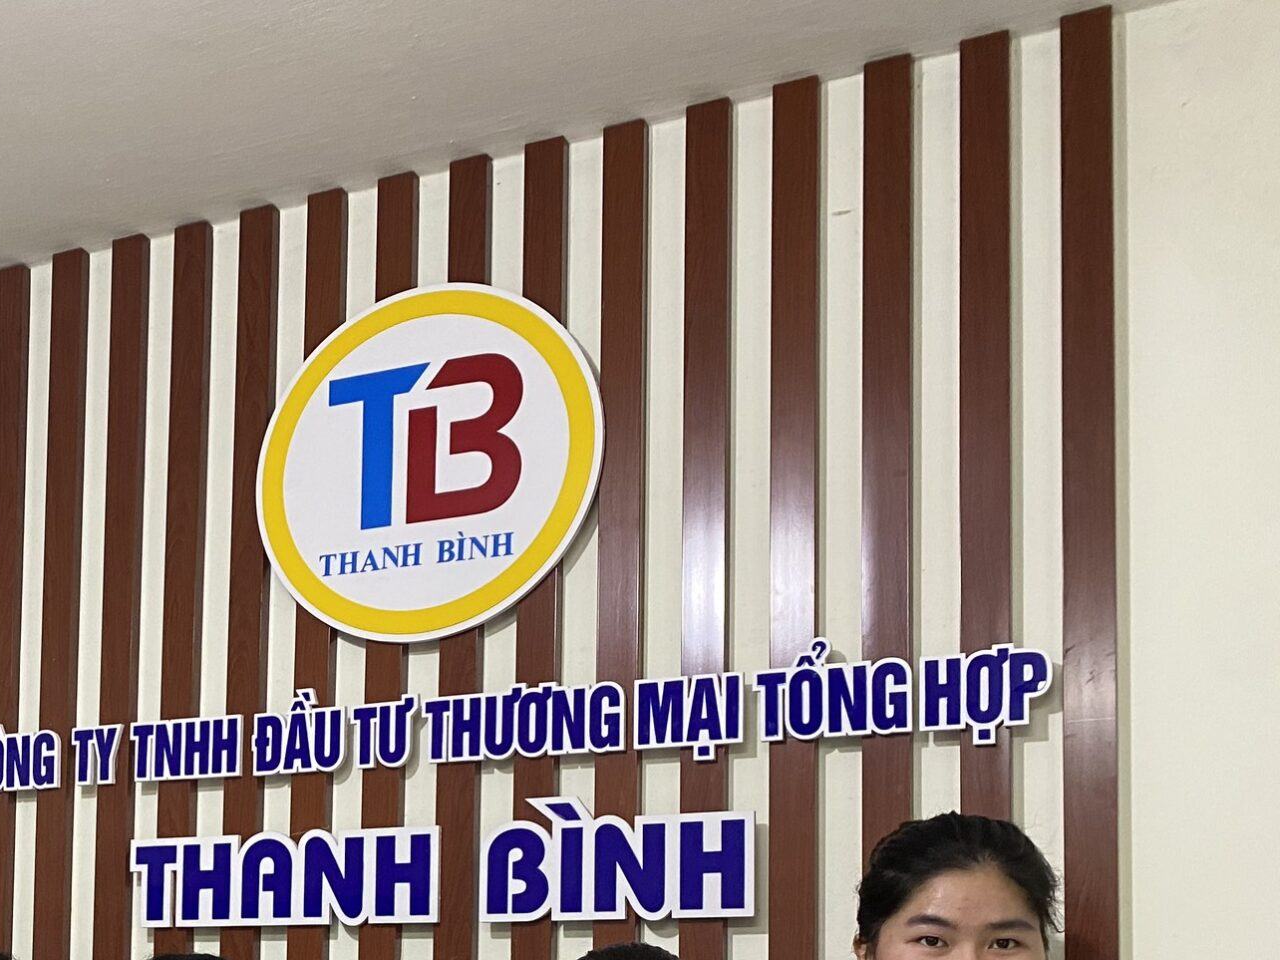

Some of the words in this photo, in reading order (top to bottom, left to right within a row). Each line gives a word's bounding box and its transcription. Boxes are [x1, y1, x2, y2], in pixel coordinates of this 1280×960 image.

[329, 353, 523, 530] TB
[319, 543, 421, 577] THANH
[436, 531, 514, 564] BÌNH
[73, 728, 117, 784] TY
[133, 717, 238, 780] TNHH
[254, 690, 341, 772] ĐẦU
[354, 696, 414, 767] TƯ
[427, 684, 620, 762] THƯƠNG
[638, 675, 740, 757] MẠI
[757, 641, 908, 739] TỔNG
[924, 647, 1048, 741] HỢP
[135, 833, 432, 922] THANH
[487, 802, 746, 915] BÌNH
